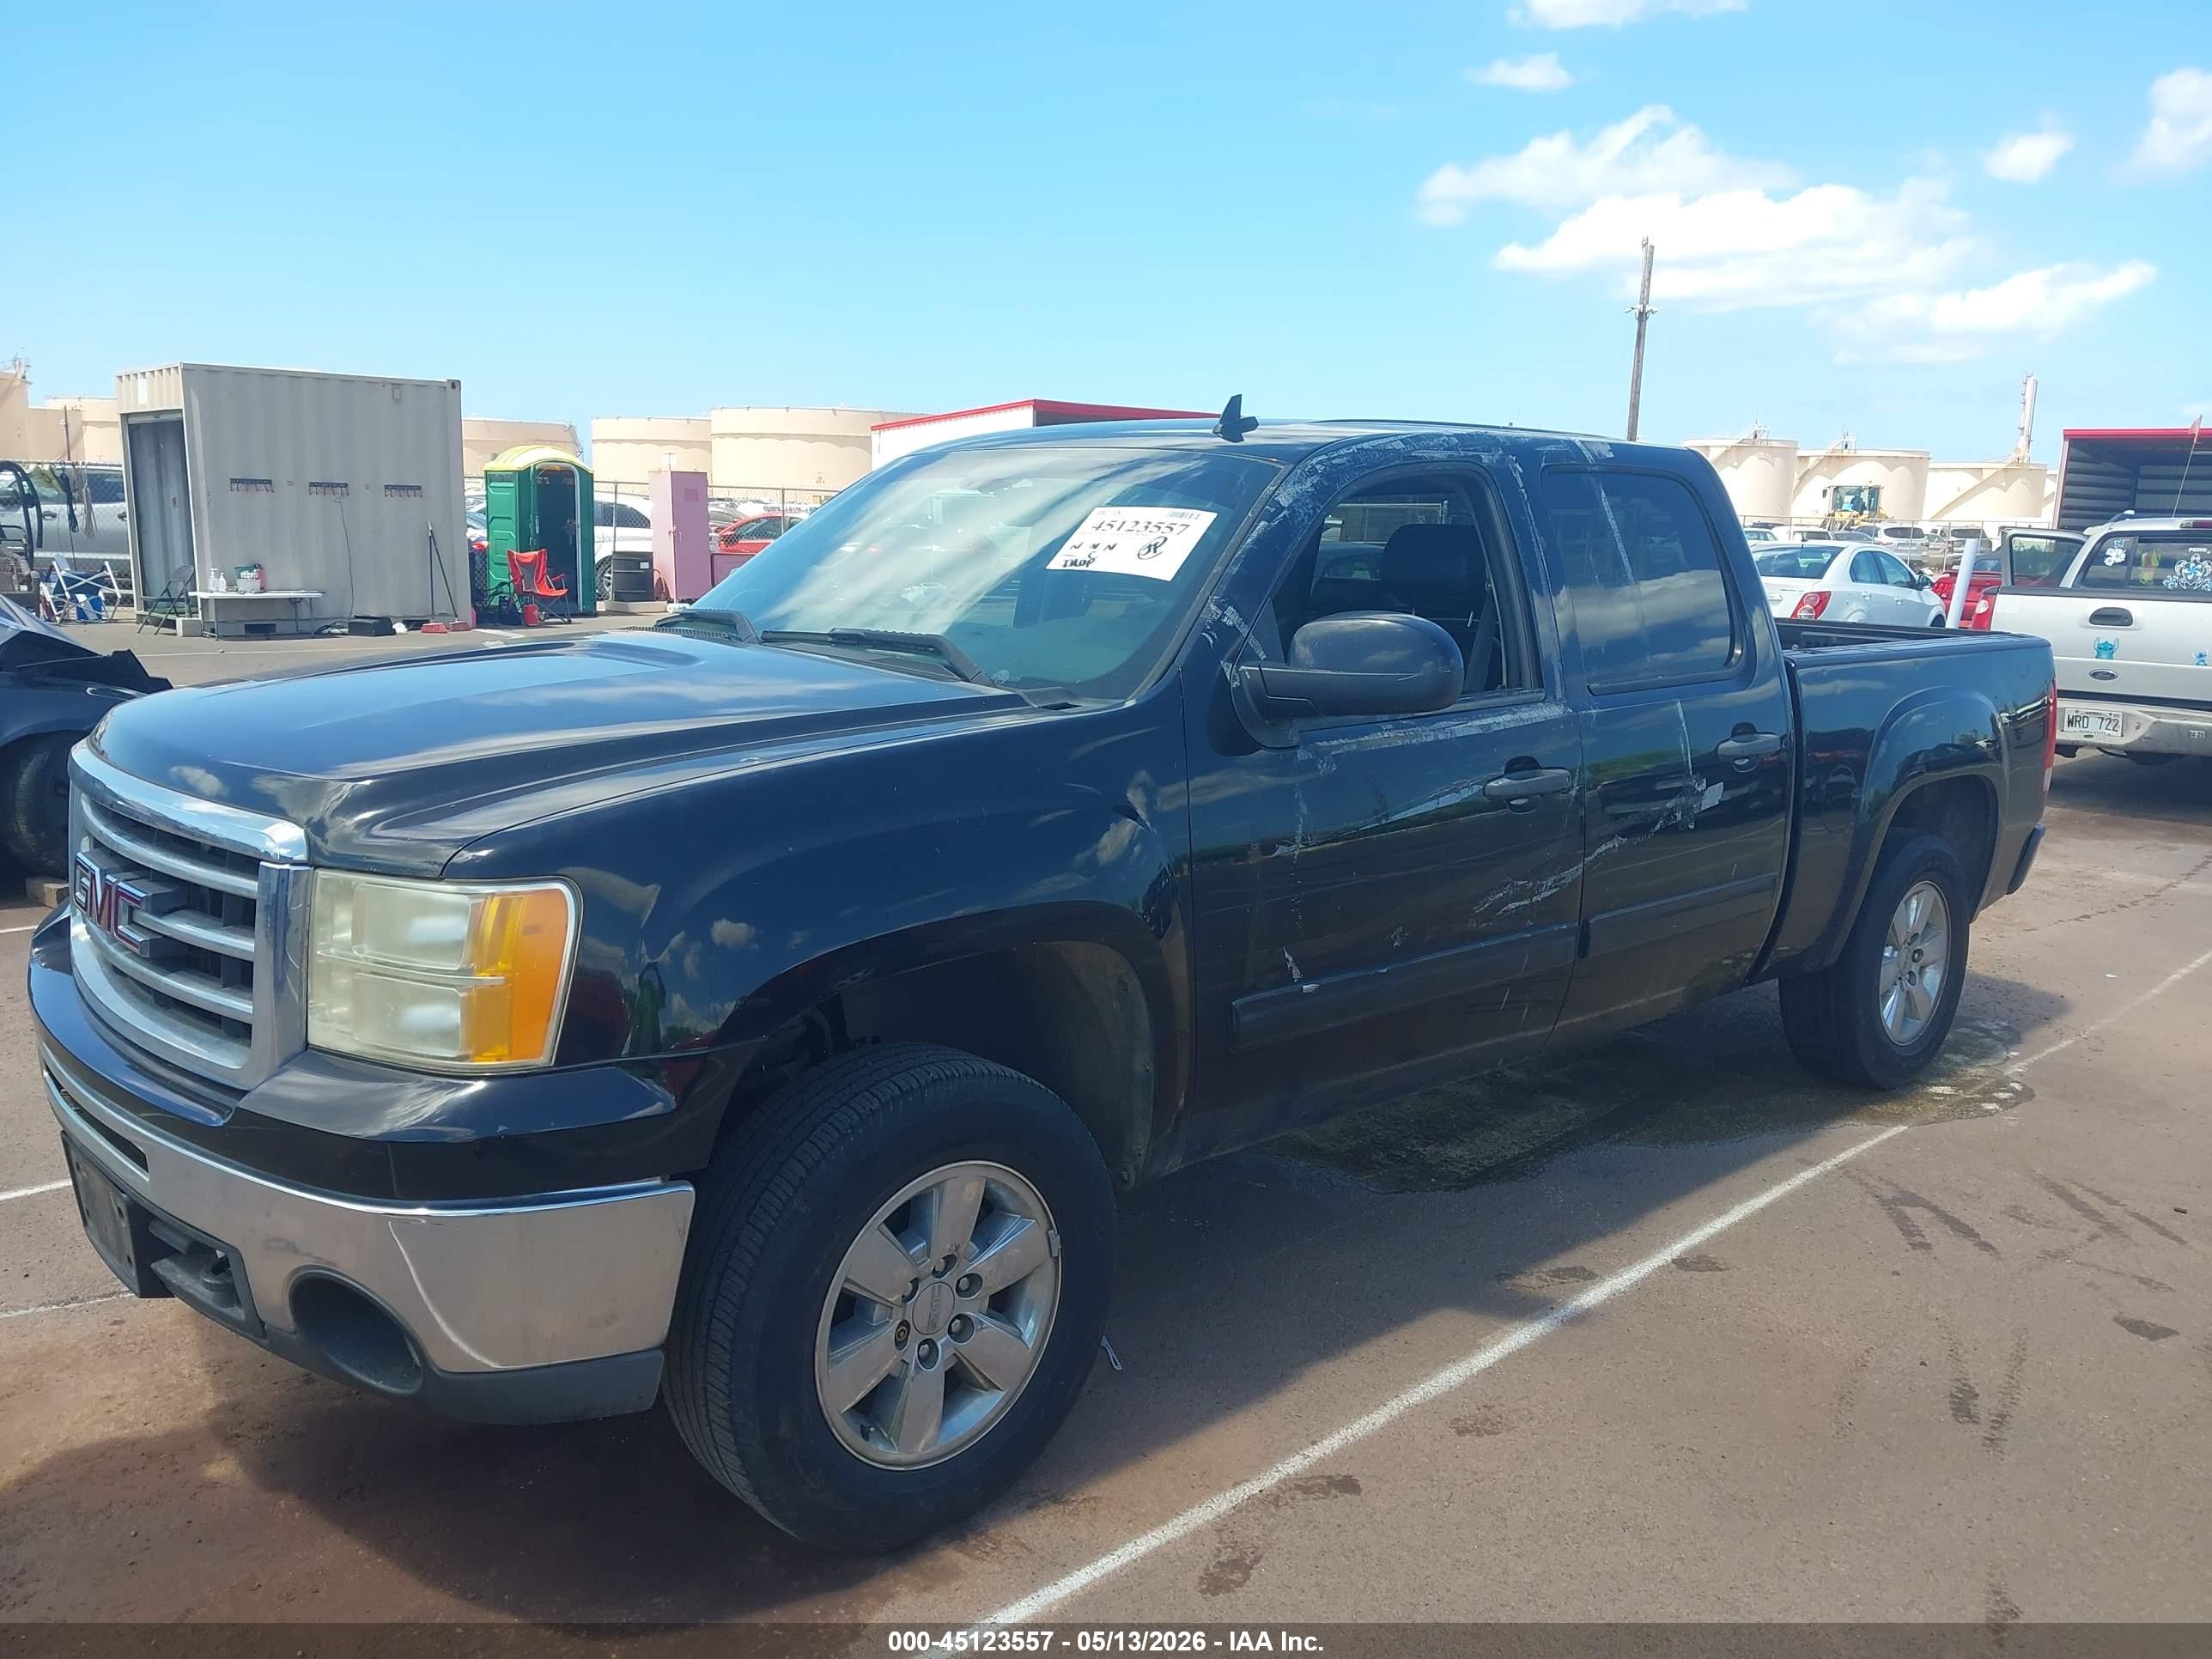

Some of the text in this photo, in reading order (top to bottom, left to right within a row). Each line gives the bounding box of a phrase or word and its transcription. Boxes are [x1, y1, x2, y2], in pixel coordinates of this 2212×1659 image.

[1092, 520, 1192, 536] 45123557
[2067, 714, 2120, 732] WRD 722
[74, 852, 149, 957] GMC
